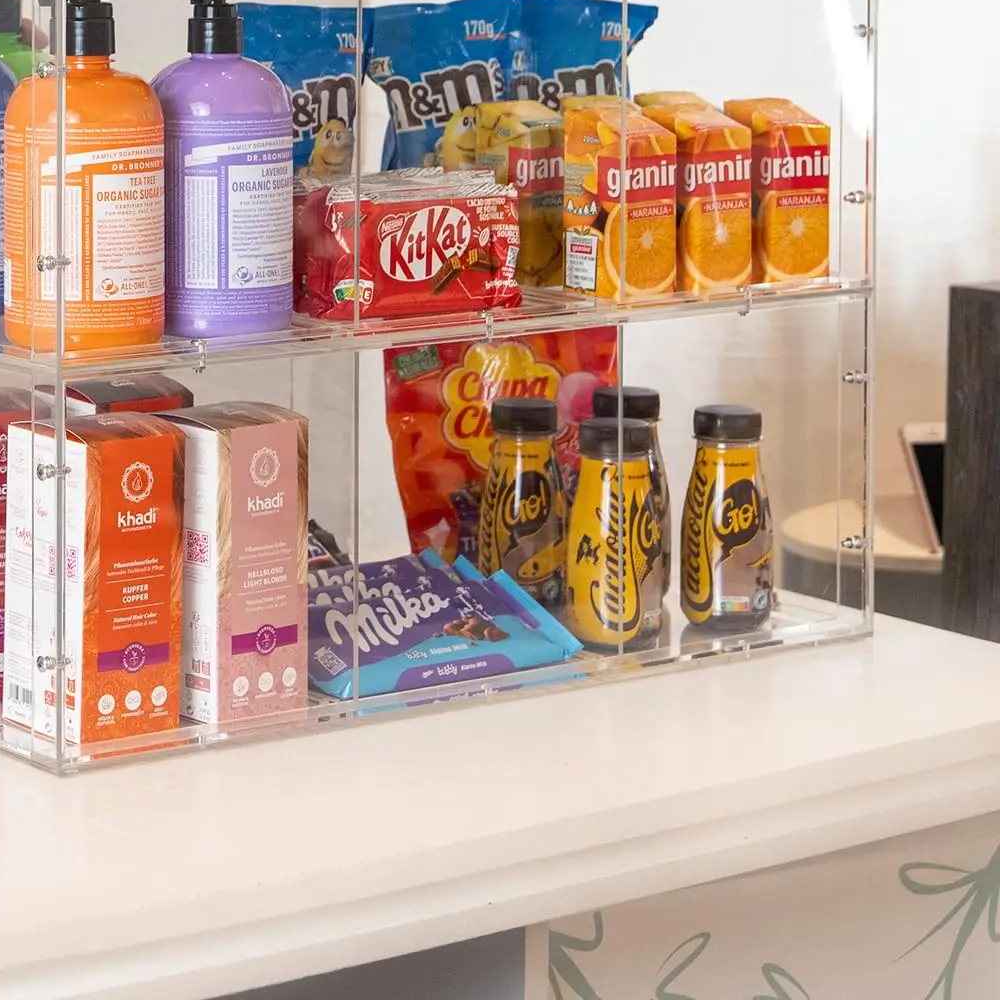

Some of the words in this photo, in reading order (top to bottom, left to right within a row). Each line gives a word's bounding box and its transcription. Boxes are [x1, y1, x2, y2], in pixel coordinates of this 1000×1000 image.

[463, 20, 494, 39] 170g
[92, 152, 117, 160] FAMILY
[130, 177, 142, 186] TEA
[143, 176, 156, 186] TREE
[232, 181, 271, 192] ORGANIC
[96, 190, 138, 202] ORGANIC
[781, 196, 823, 205] NARANJA
[631, 207, 669, 219] NARANJA
[706, 202, 745, 212] NARANJA
[389, 207, 467, 280] KitKat
[247, 492, 284, 512] khadi
[717, 488, 759, 535] Go!
[117, 508, 157, 528] khadi
[247, 566, 284, 579] HELLBLOND
[243, 579, 262, 589] LIGHT
[263, 575, 287, 585] BLONDE
[122, 583, 149, 594] KUPFER
[122, 592, 149, 604] COPPER
[325, 592, 450, 653] Milka
